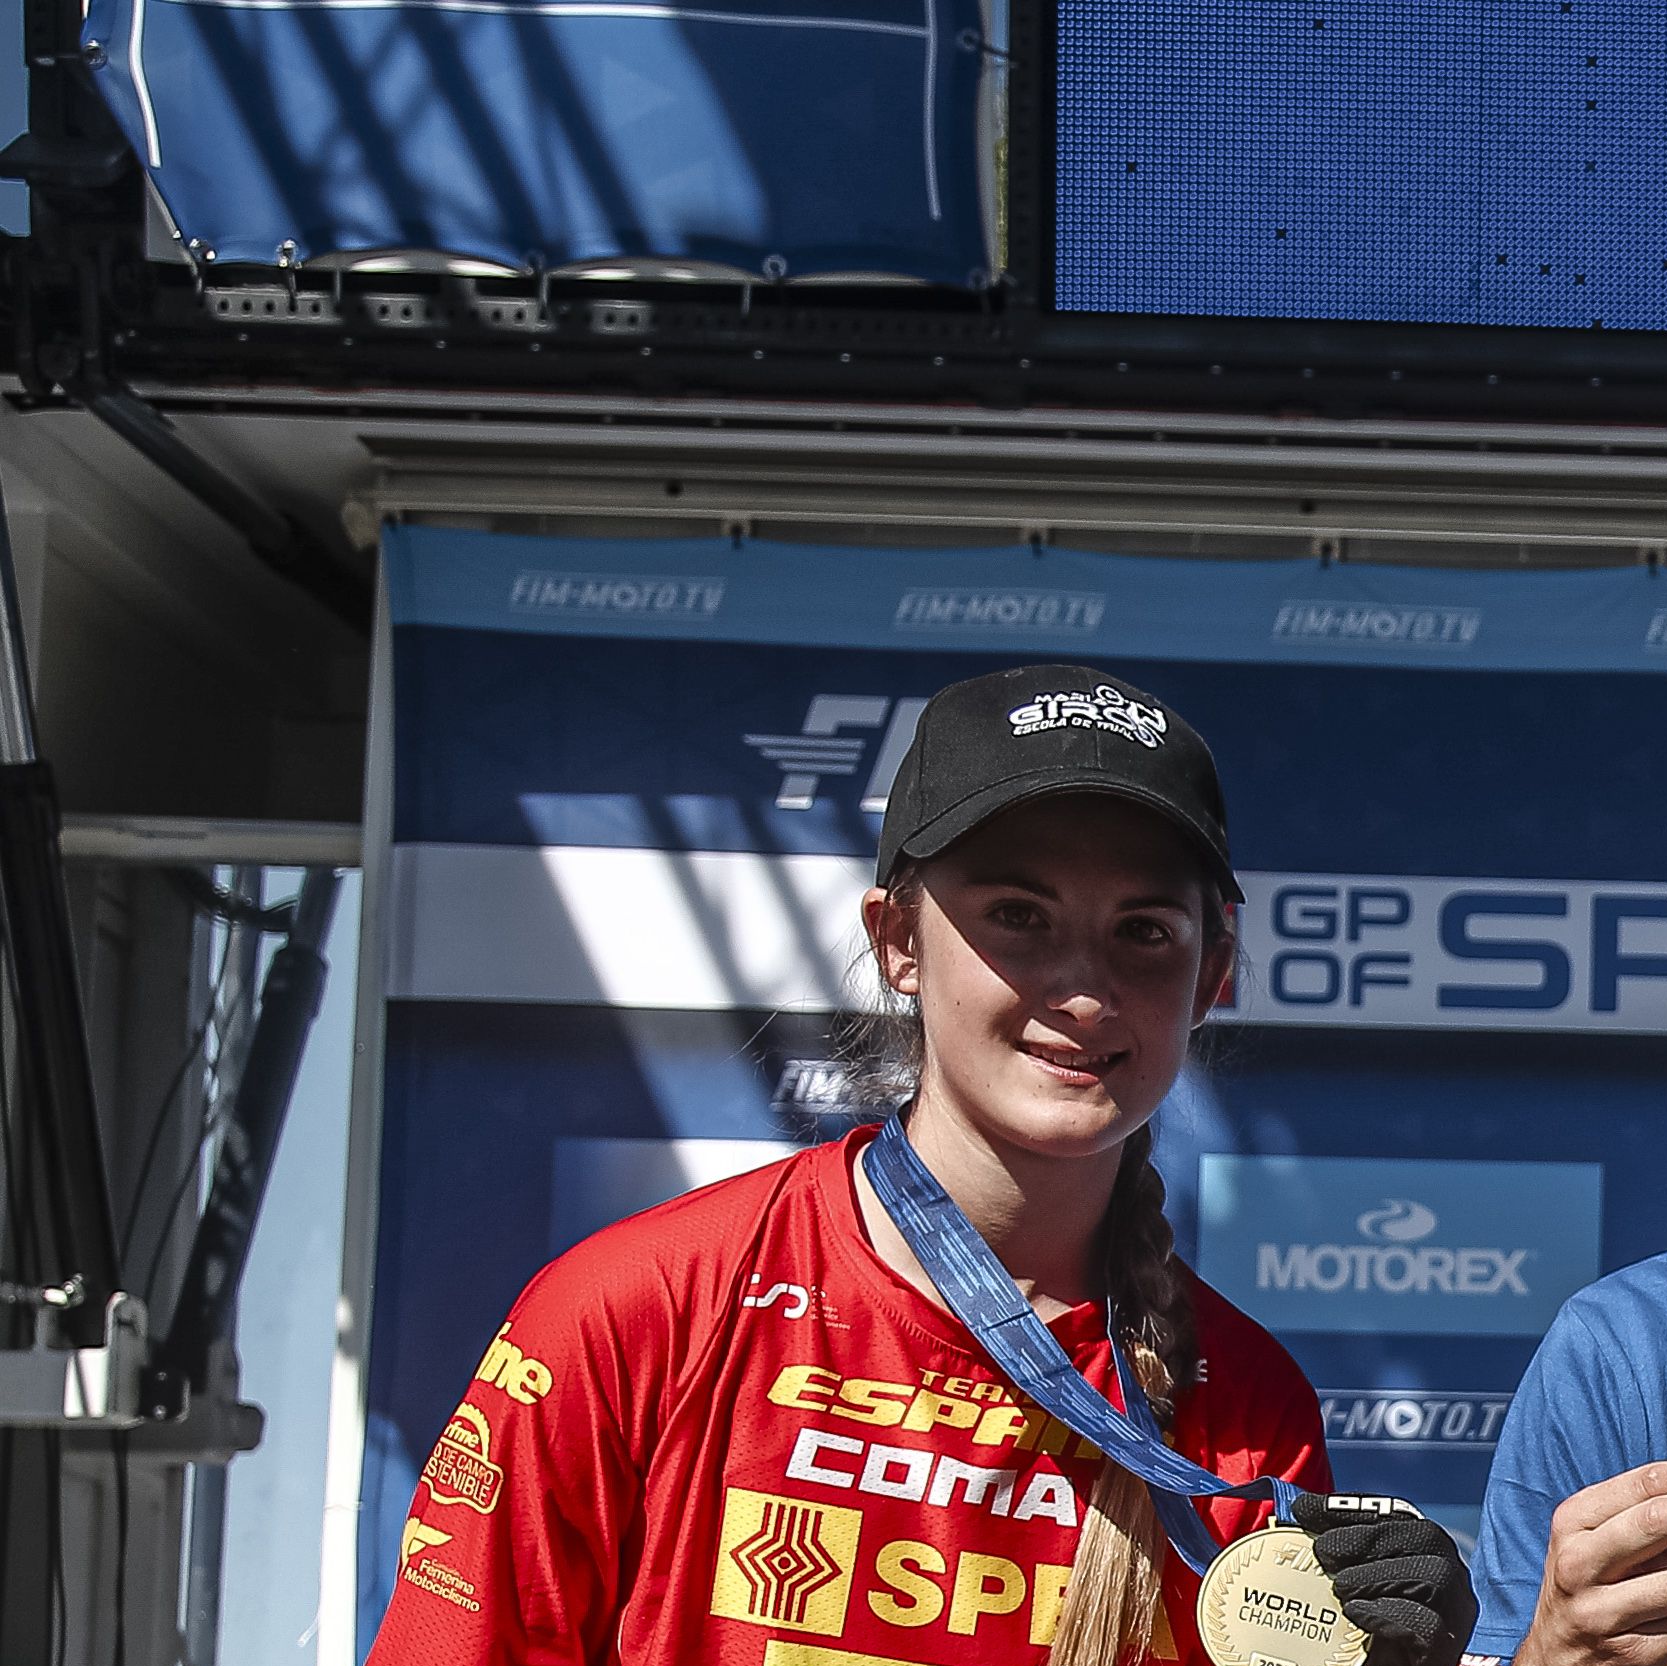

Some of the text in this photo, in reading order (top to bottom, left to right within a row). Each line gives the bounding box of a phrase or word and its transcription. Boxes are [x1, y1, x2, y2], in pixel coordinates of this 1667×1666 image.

[1271, 885, 1412, 944] GP
[1270, 950, 1412, 1008] OF
[1256, 1242, 1530, 1295] MOTOREX
[784, 1427, 1078, 1528] COMA
[404, 1566, 481, 1613] Motociclismo
[419, 1558, 475, 1596] Femenina
[1238, 1605, 1334, 1644] CHAMPION
[1243, 1586, 1339, 1625] WORLD
